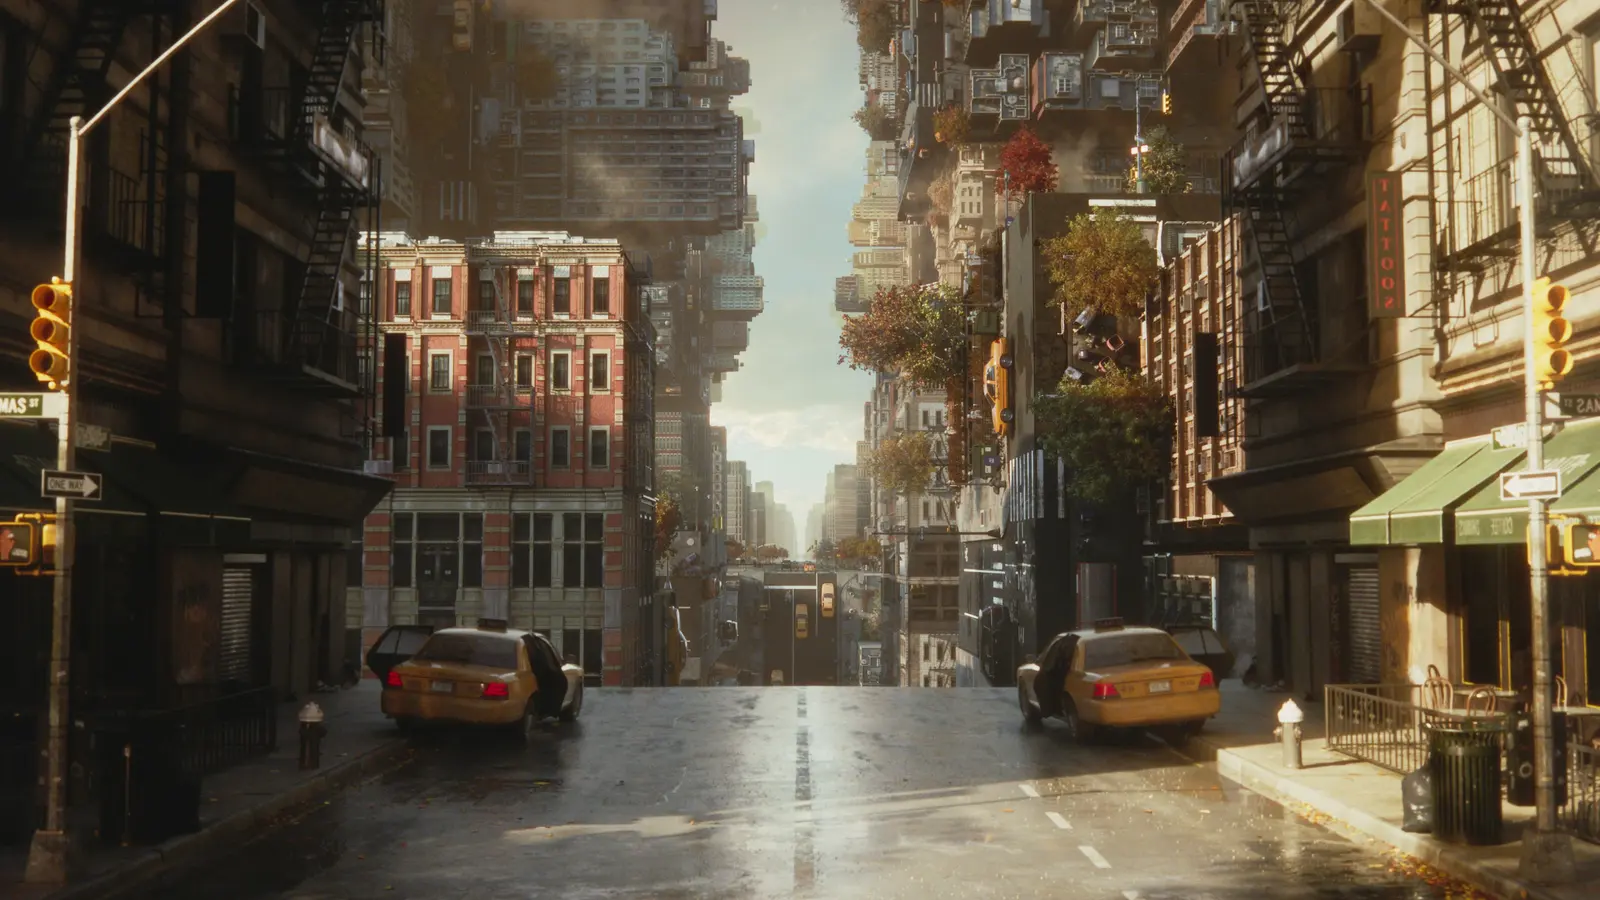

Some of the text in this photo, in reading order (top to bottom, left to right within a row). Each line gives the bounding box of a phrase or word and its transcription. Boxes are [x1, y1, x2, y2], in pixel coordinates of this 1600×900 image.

[29, 397, 40, 408] ST
[50, 479, 83, 490] ONE WAY
